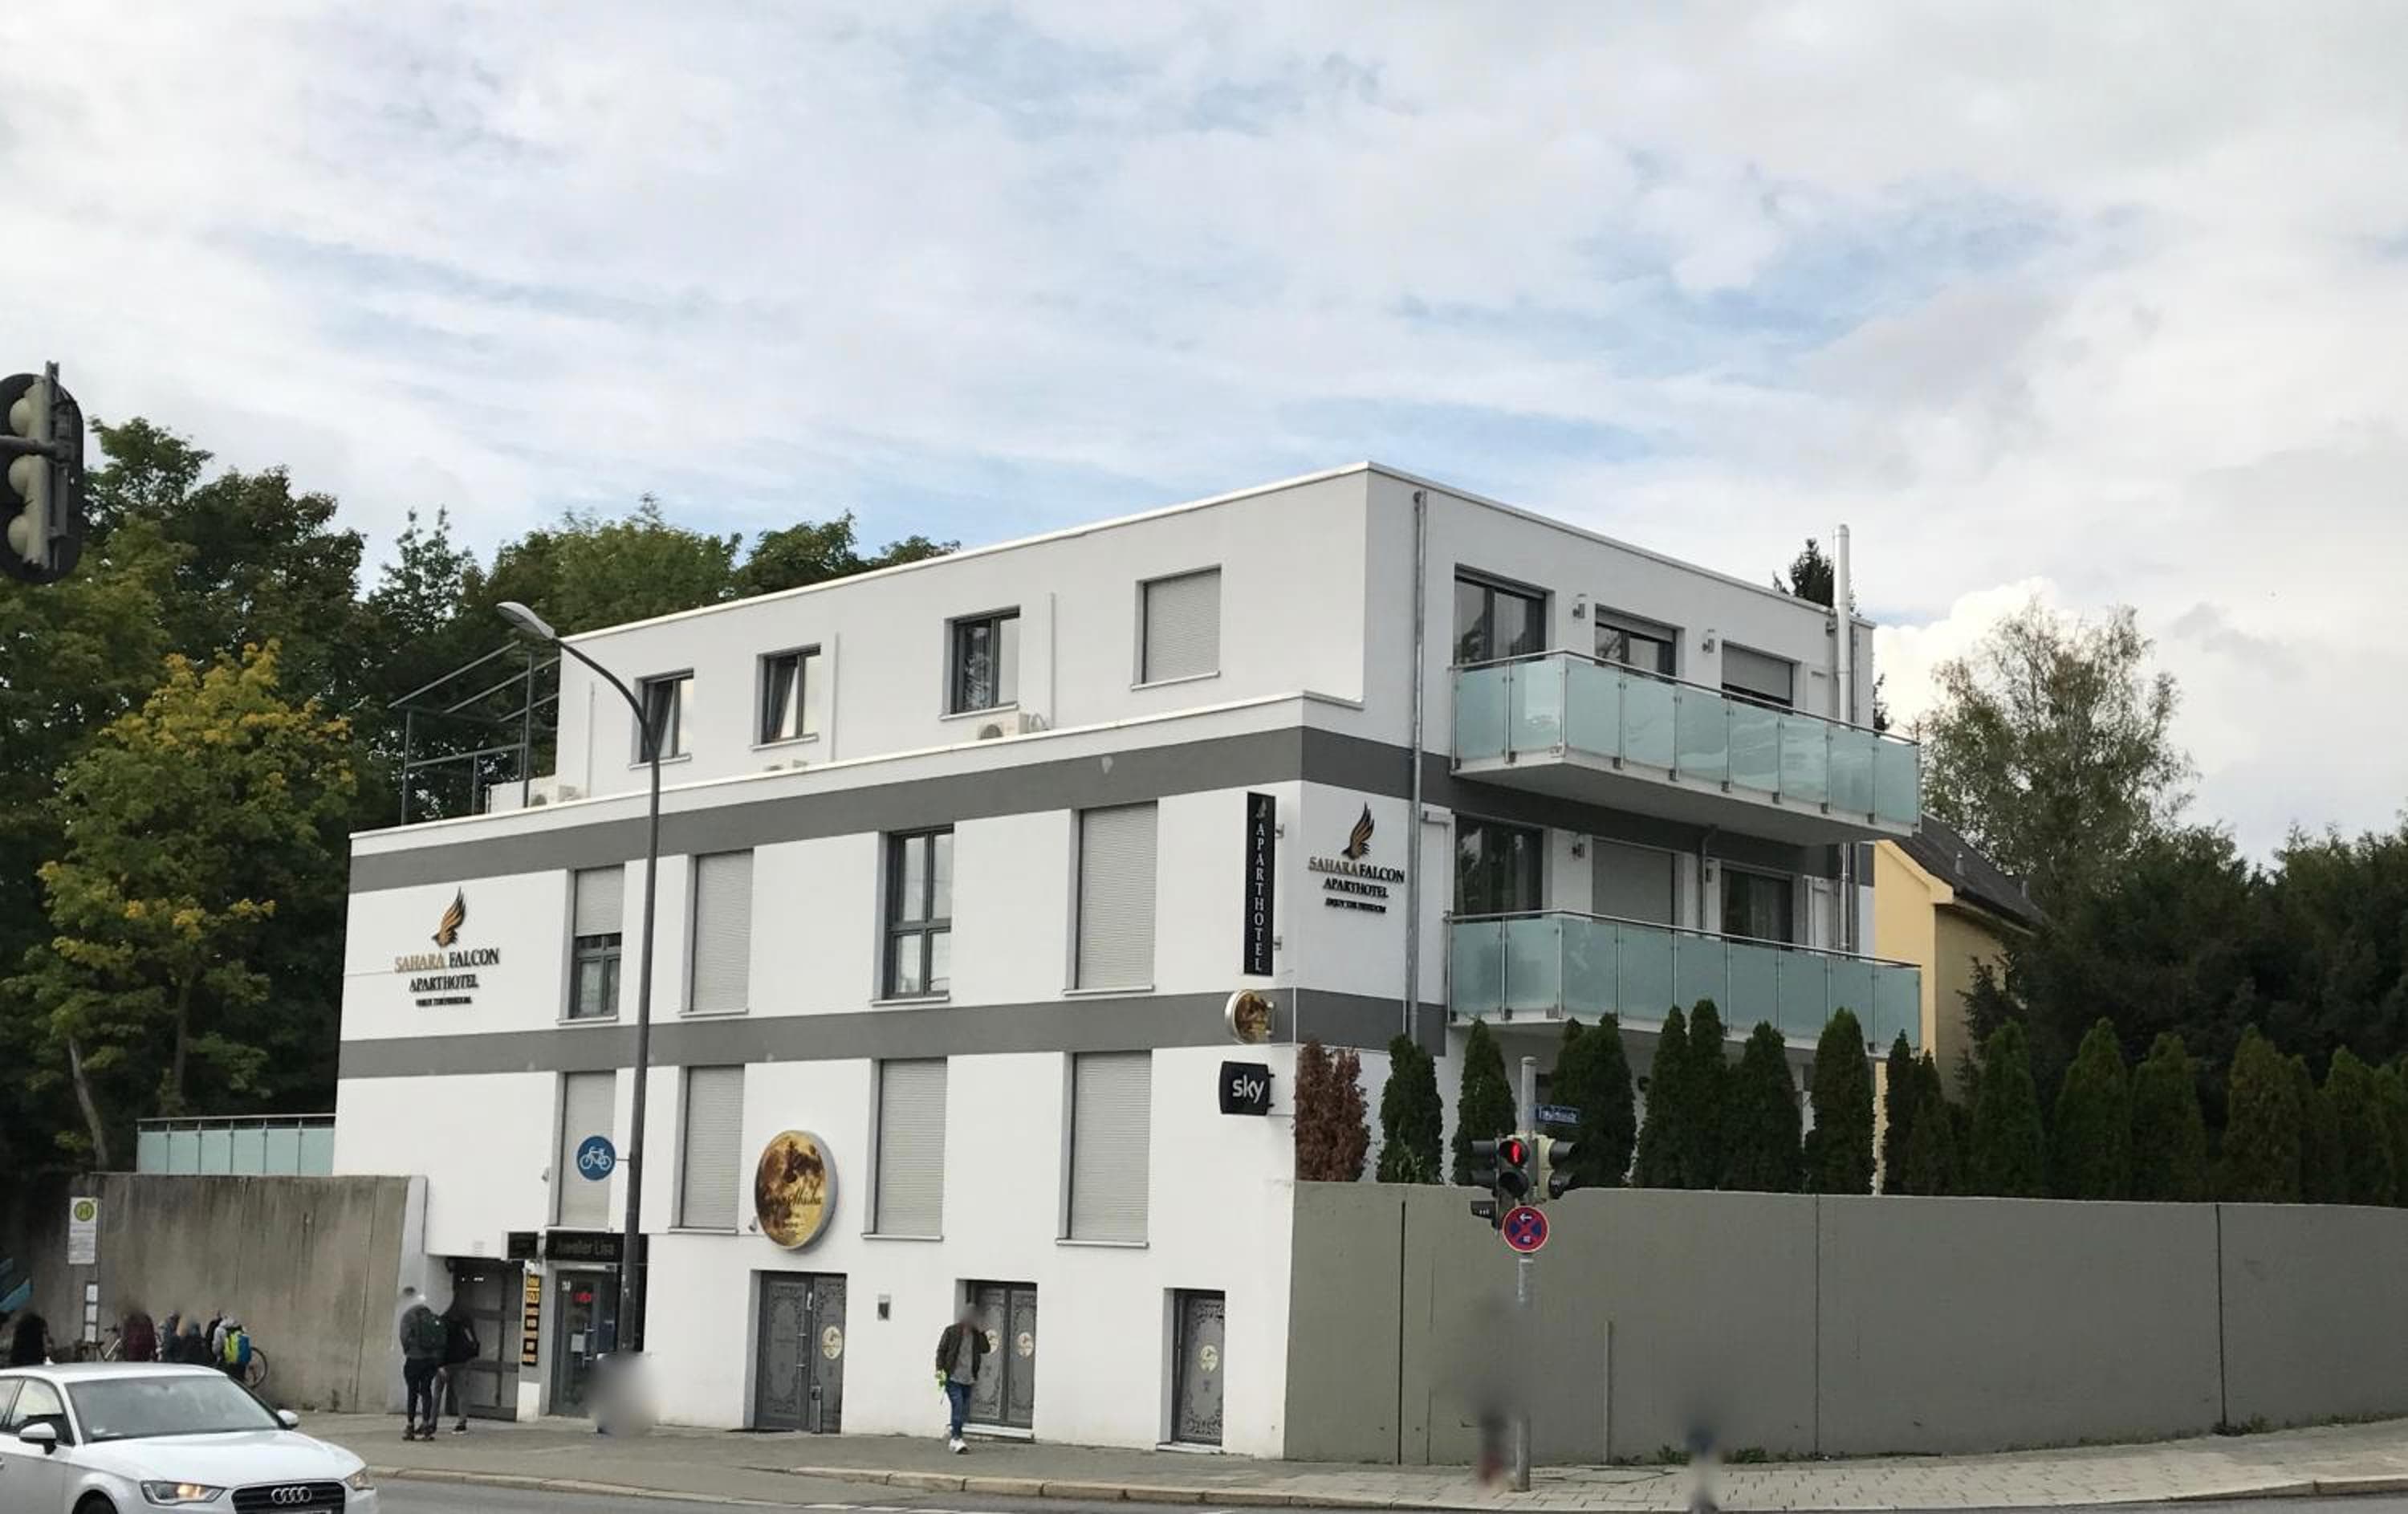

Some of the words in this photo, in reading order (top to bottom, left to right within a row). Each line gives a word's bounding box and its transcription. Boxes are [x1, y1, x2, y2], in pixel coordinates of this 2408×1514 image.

[1308, 857, 1358, 877] SAHARA
[1360, 864, 1405, 883] FALCON
[1253, 823, 1266, 971] APARTHOTEL
[1323, 877, 1389, 899] APARTHOTEL
[394, 953, 445, 974] SAHARA
[449, 948, 500, 968] FALCON
[409, 974, 479, 992] APARTHOTEL
[1232, 1075, 1264, 1104] sky
